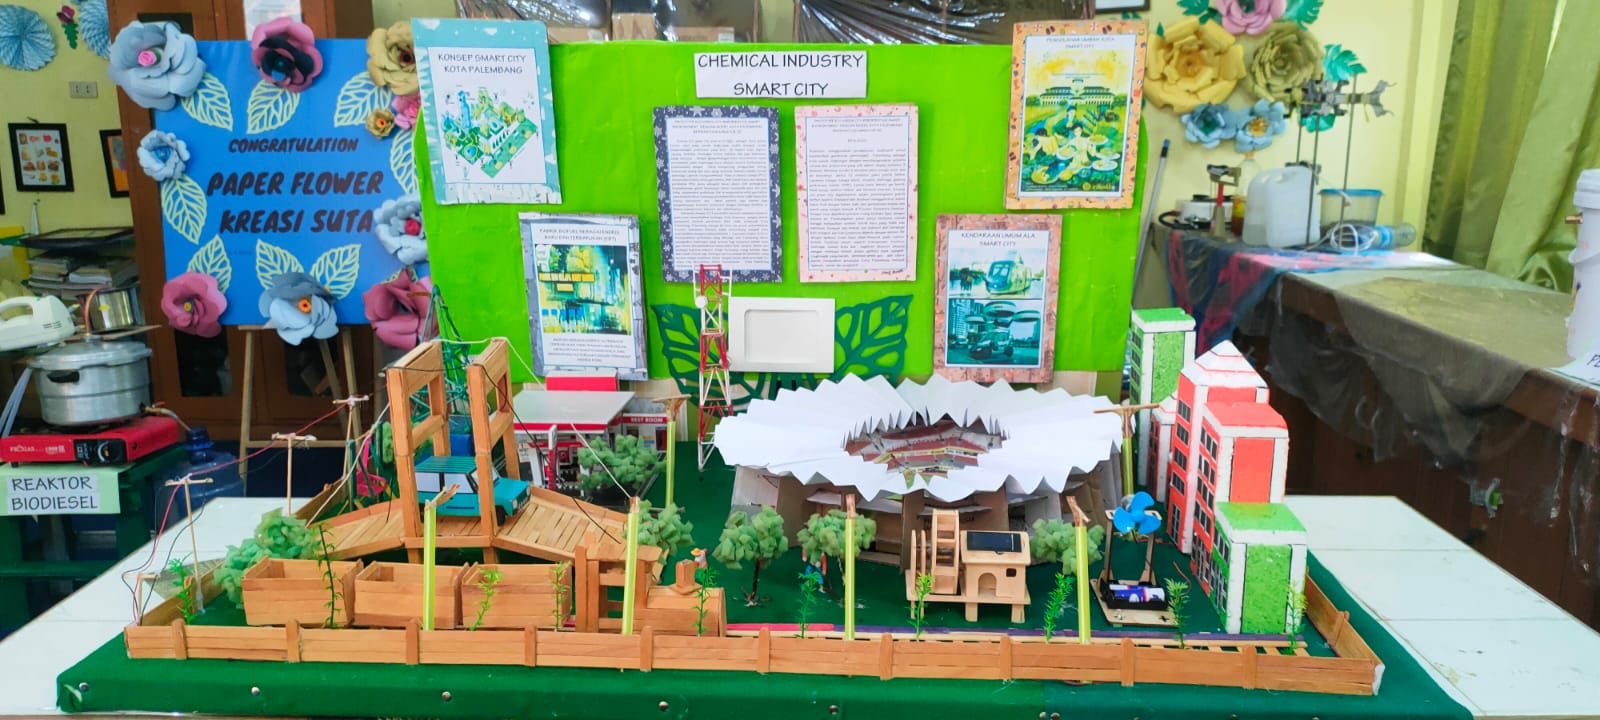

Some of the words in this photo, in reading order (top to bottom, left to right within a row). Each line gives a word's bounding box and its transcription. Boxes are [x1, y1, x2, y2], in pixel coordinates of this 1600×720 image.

[438, 53, 473, 62] KONSEP
[474, 54, 505, 63] SMART
[507, 55, 526, 63] CITY
[698, 54, 779, 68] CHEMICAL
[782, 54, 864, 68] INDUSTRY
[444, 65, 467, 73] KOTA
[468, 65, 523, 74] PALEMBANG
[733, 82, 791, 96] SMART
[794, 82, 829, 96] CITY
[228, 138, 359, 153] CONGRATULATION
[207, 171, 285, 196] PAPER
[290, 171, 384, 196] FLOWER
[310, 209, 375, 233] SUTA
[12, 476, 93, 491] REAKTOR
[12, 495, 98, 511] BIODIESEL
